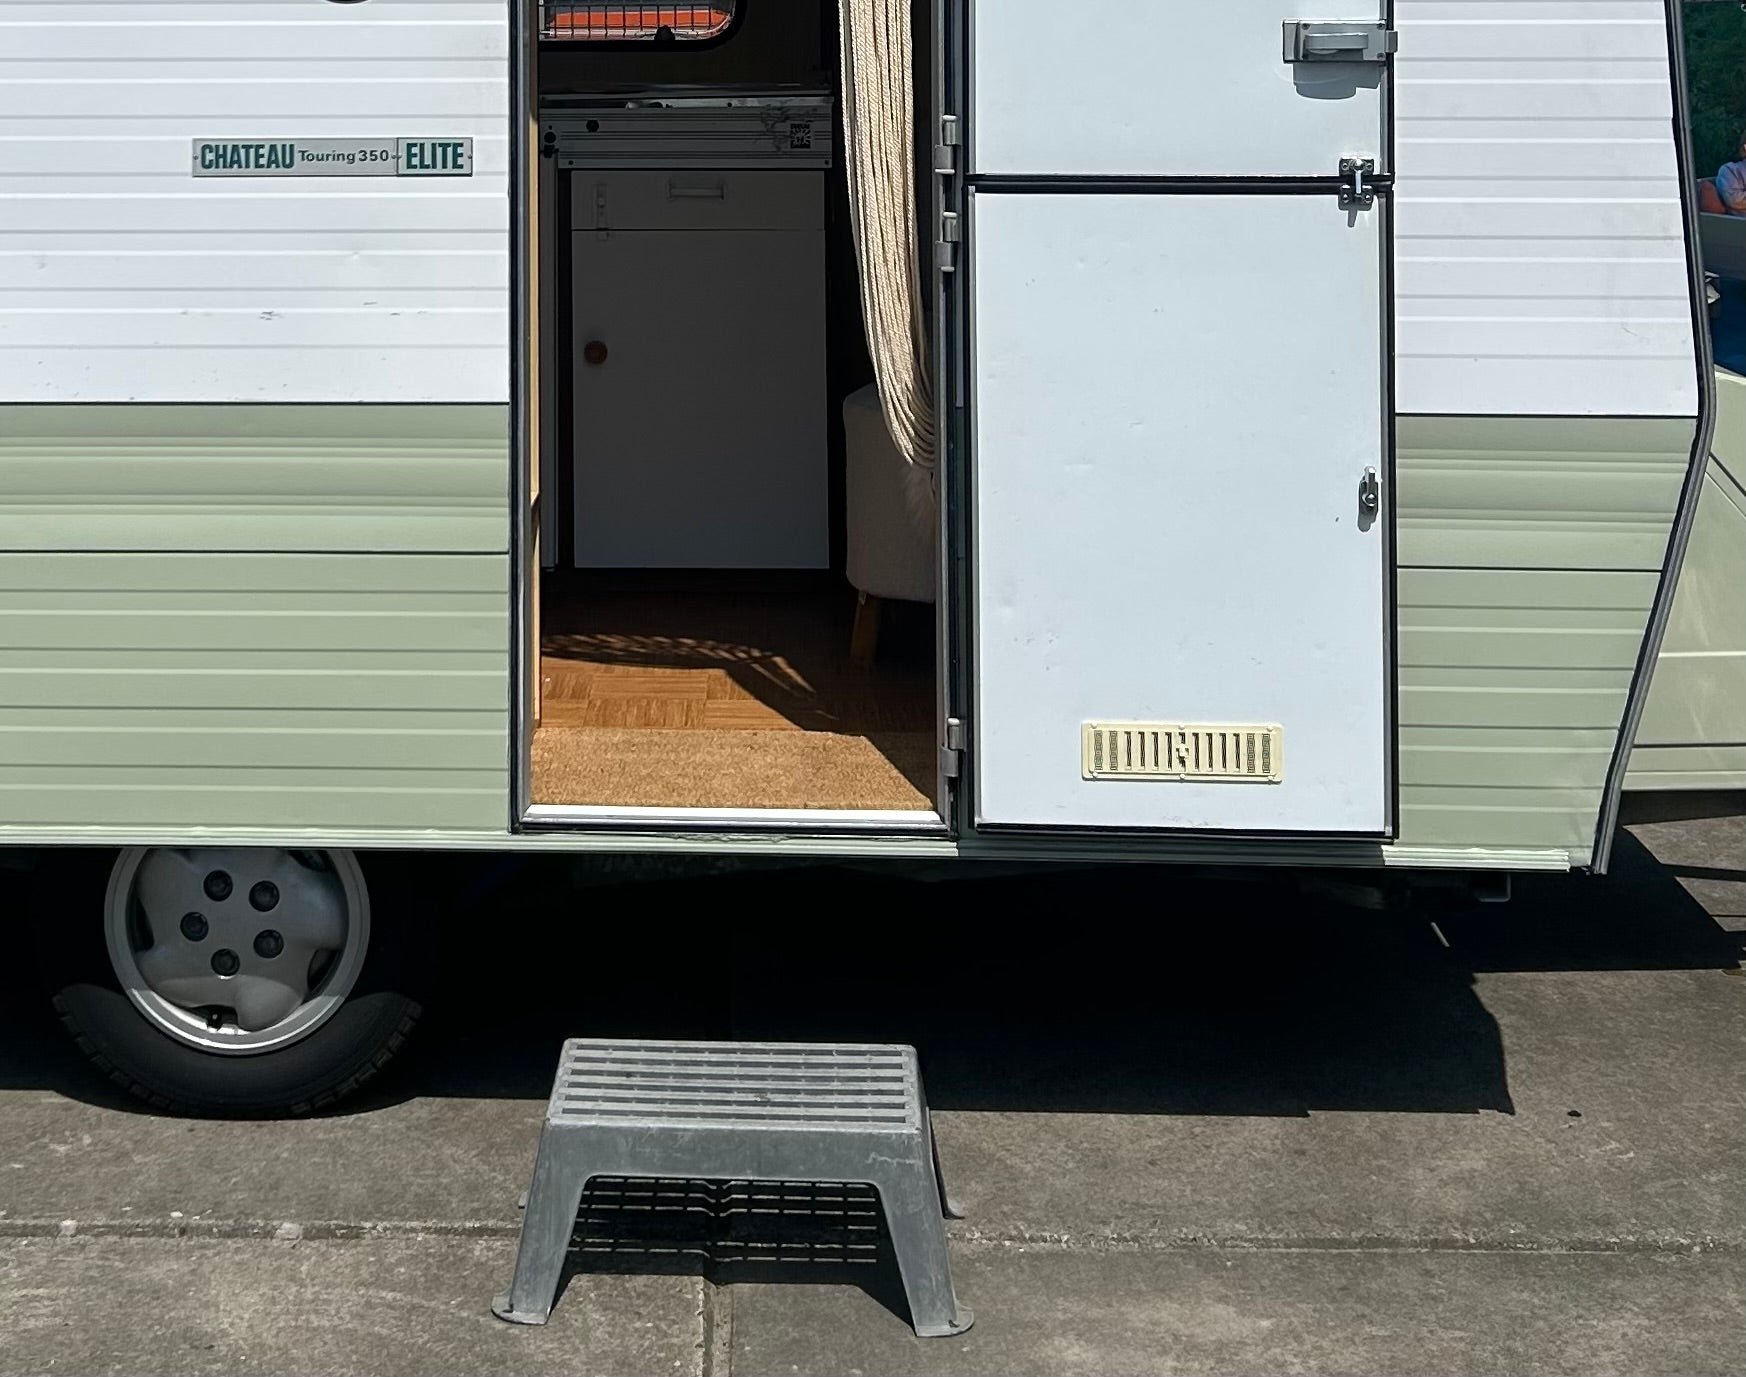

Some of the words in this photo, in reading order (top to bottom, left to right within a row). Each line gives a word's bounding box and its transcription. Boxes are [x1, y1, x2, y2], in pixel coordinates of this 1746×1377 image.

[201, 143, 295, 169] CHATEAU
[298, 149, 356, 165] Touring
[358, 149, 389, 162] 350
[406, 142, 464, 169] ELITE
